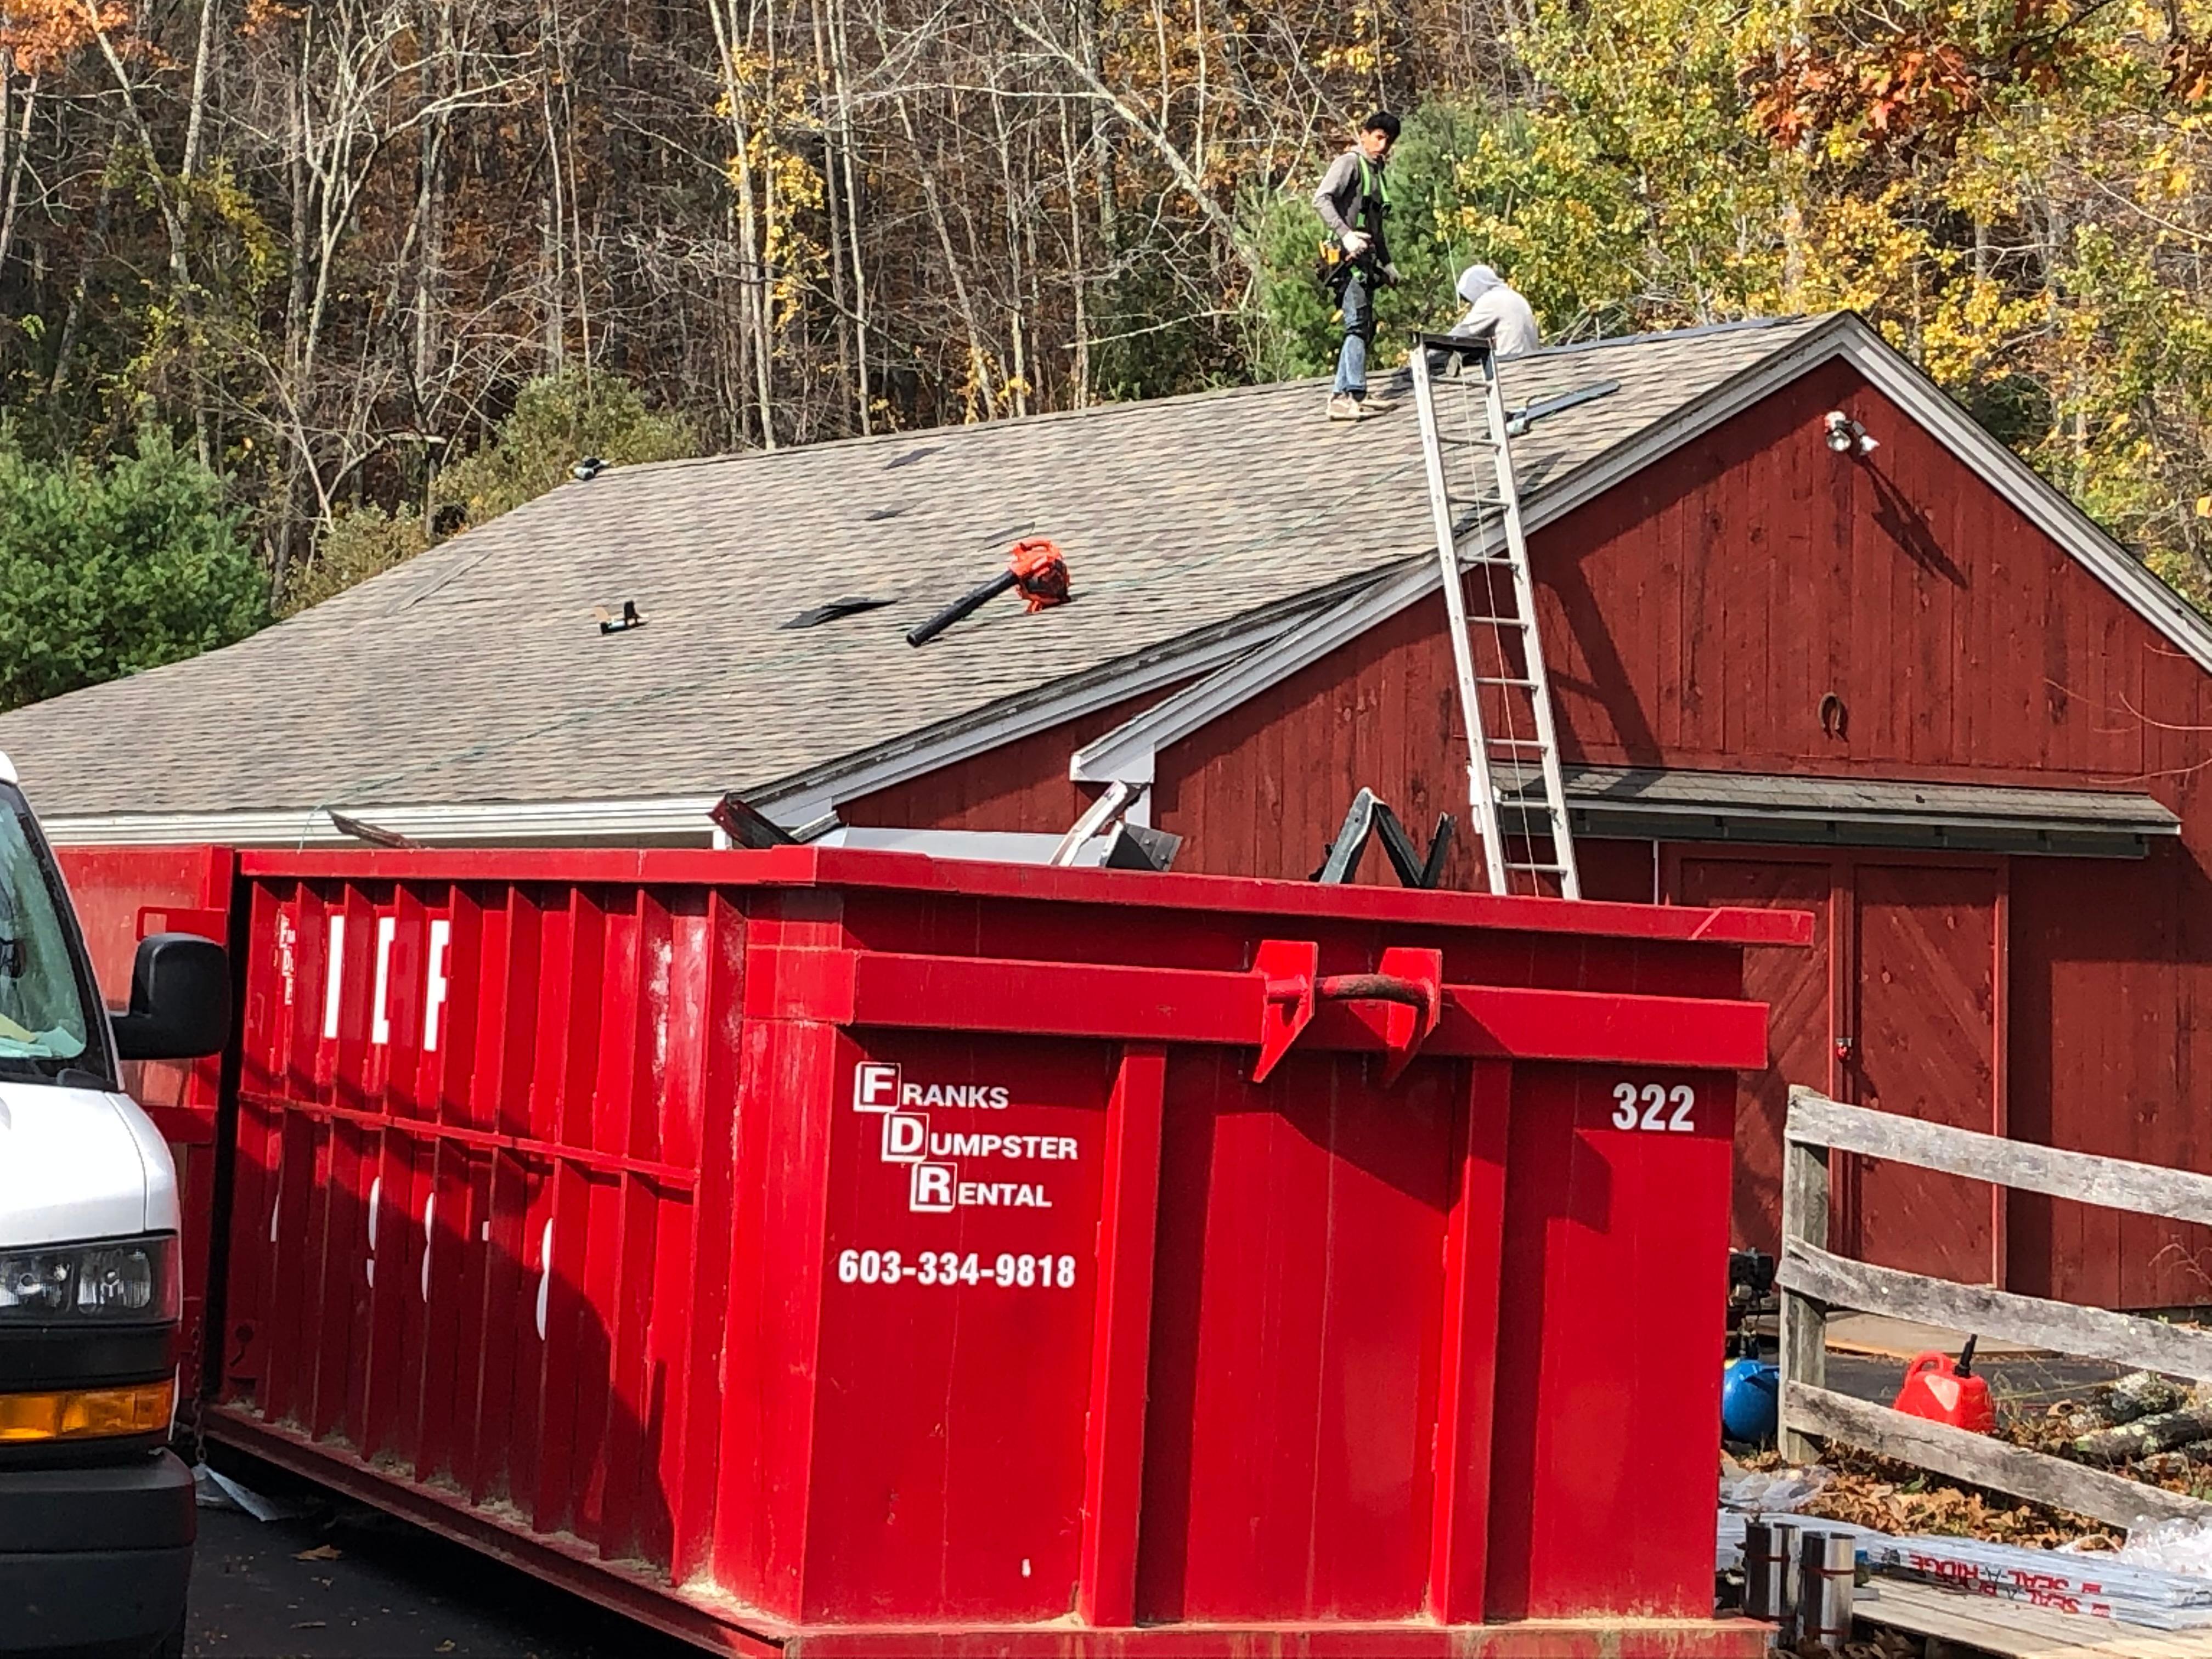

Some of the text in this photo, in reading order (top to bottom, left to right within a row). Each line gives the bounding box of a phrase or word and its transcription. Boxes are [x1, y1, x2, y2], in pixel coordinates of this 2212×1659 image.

[862, 1066, 1009, 1109] FRANKS
[1612, 1082, 1695, 1131] 322
[889, 1116, 1079, 1160] DUMPSTER
[917, 1165, 1053, 1208] RENTAL
[838, 1249, 1076, 1288] 603-334-9818
